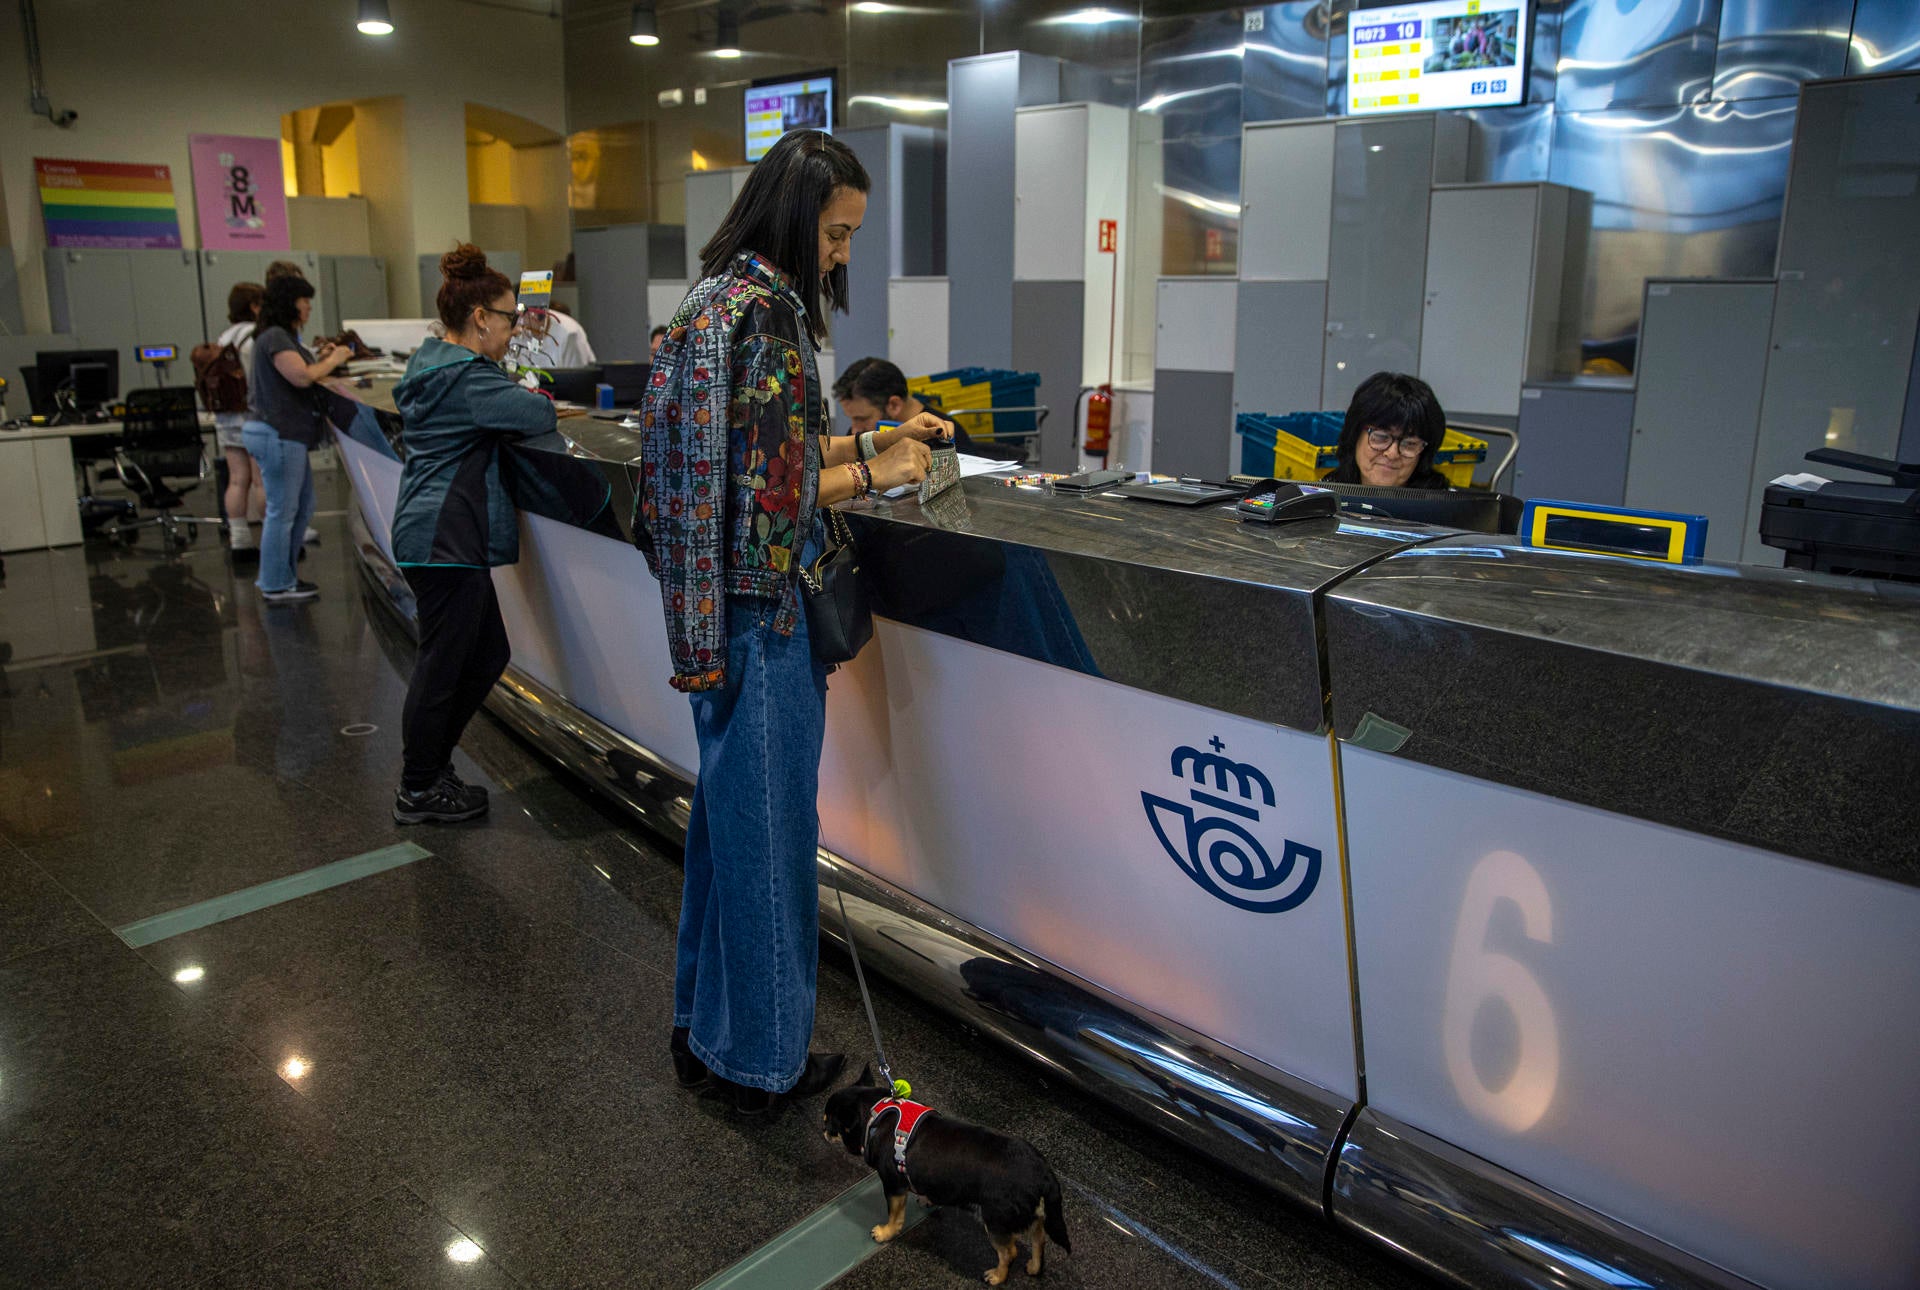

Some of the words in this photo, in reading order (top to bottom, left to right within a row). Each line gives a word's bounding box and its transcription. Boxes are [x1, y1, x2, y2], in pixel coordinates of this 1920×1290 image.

[1356, 27, 1387, 43] R073
[1396, 22, 1416, 39] 10
[231, 166, 249, 193] 8
[231, 195, 257, 217] M
[1445, 850, 1559, 1133] 6
